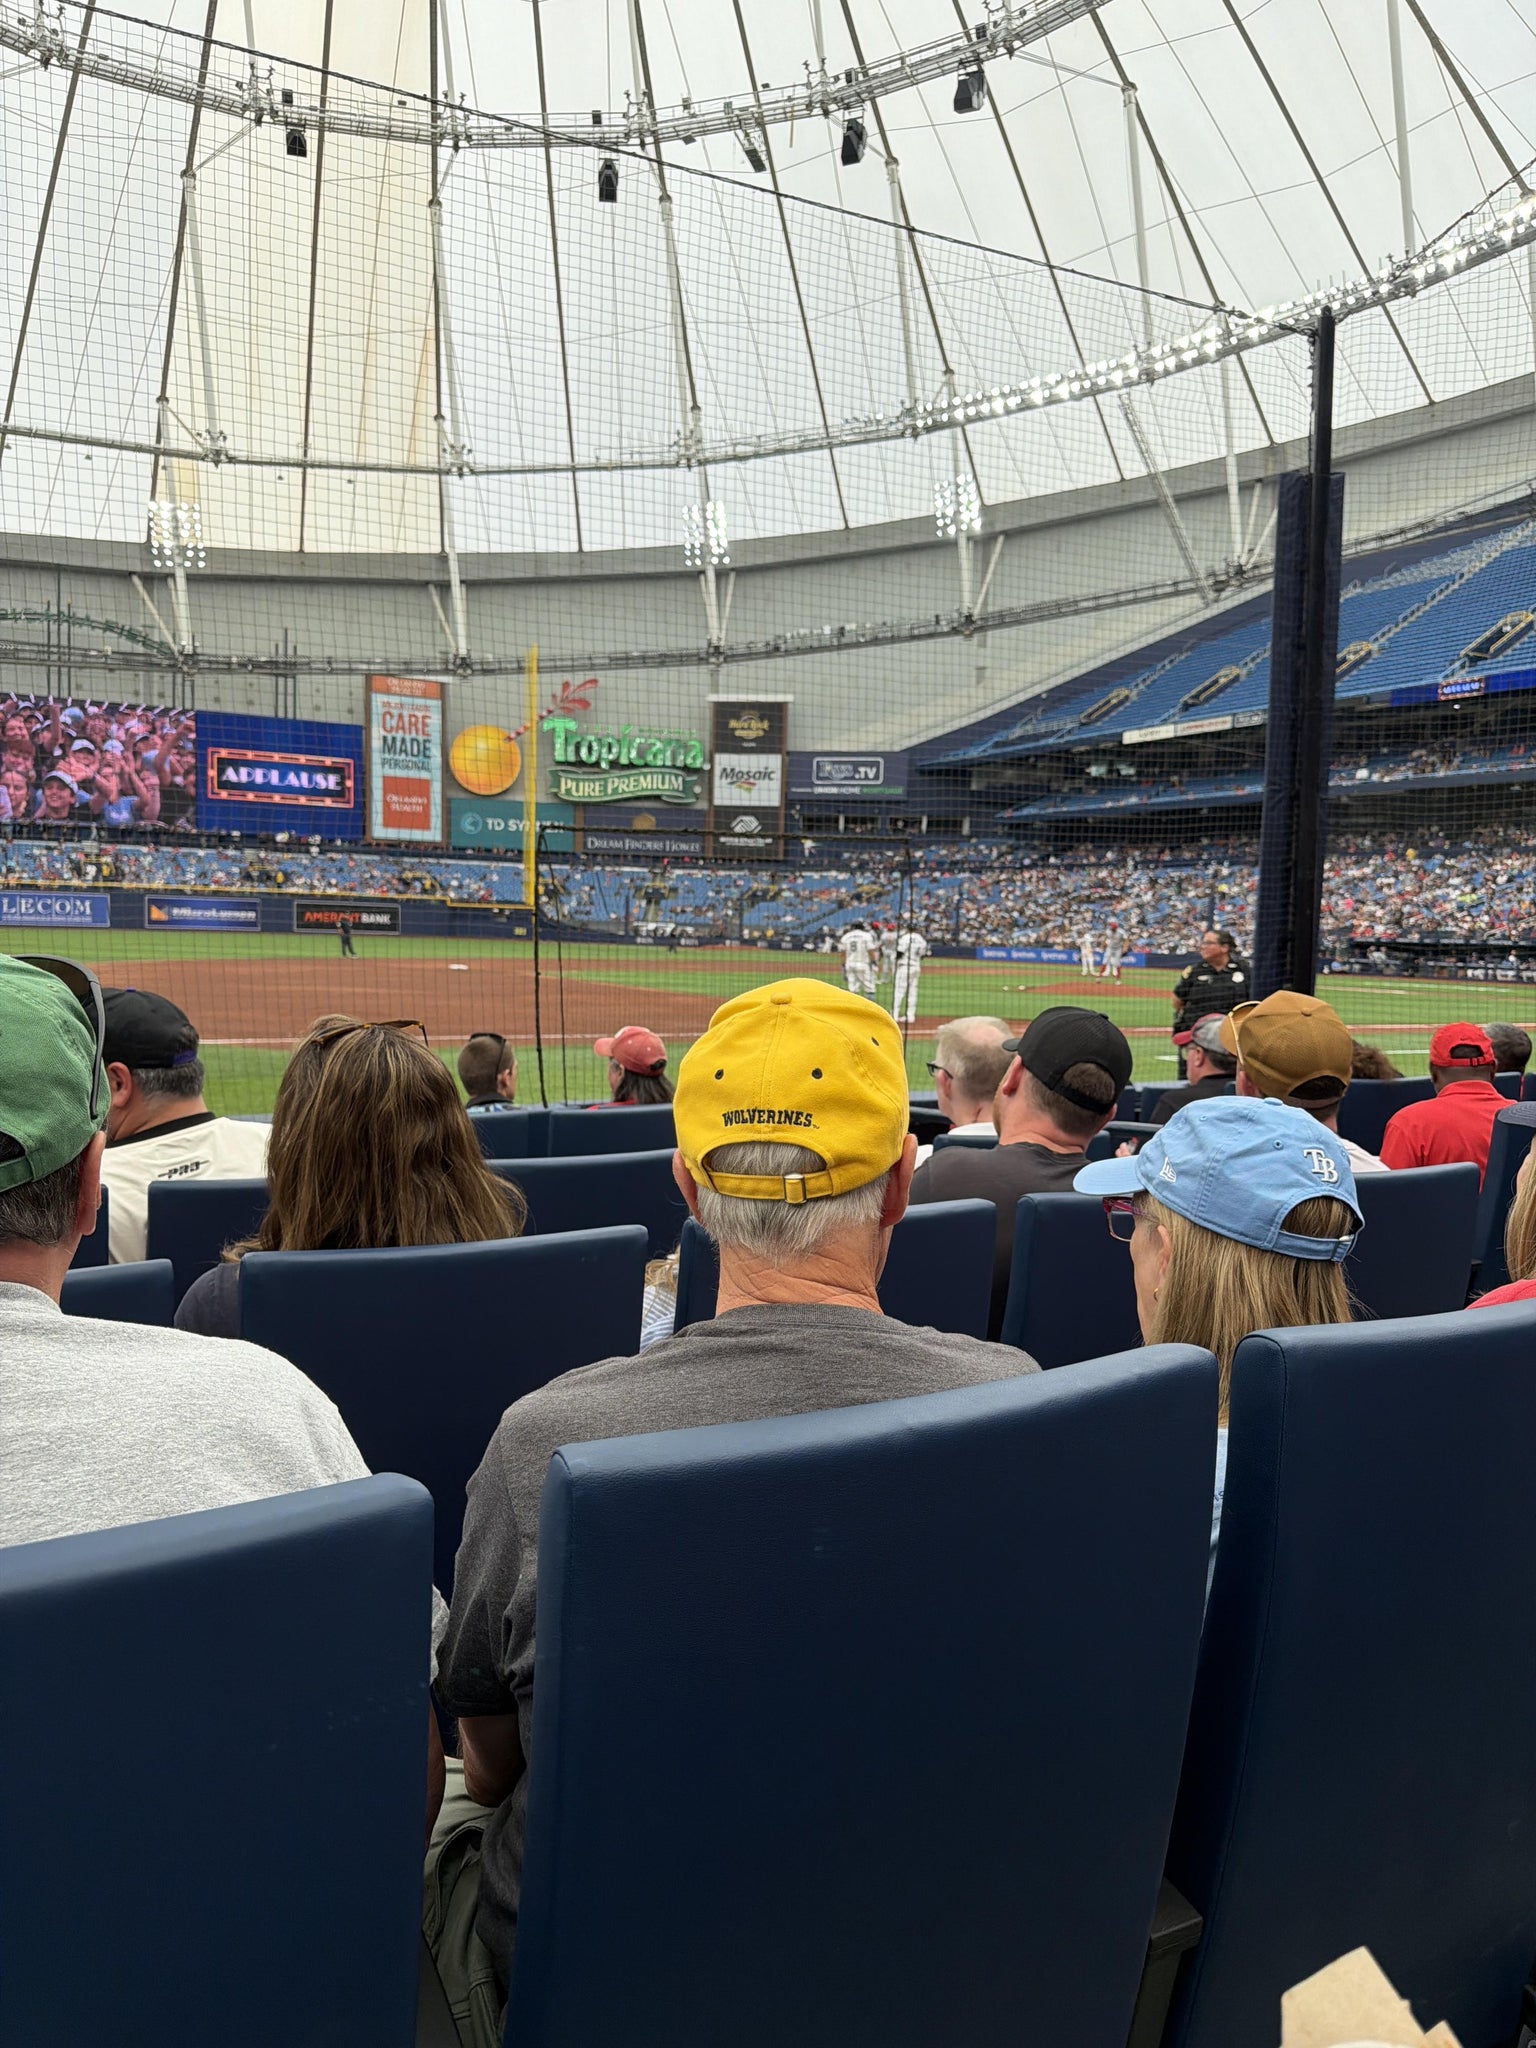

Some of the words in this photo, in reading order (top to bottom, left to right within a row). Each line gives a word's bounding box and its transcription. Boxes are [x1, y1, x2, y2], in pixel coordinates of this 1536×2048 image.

[382, 711, 432, 737] CARE
[382, 735, 432, 759] MADE
[542, 717, 704, 770] Tropicana
[381, 757, 432, 773] PERSONAL
[720, 766, 776, 781] Mosaic
[222, 766, 342, 790] APPLAUSE
[559, 776, 605, 797] PURE
[607, 773, 684, 795] PREMIUM
[485, 817, 505, 831] TD
[2, 896, 92, 916] LECOM
[360, 912, 392, 925] BANK
[722, 1107, 813, 1127] WOLVERINES
[1303, 1149, 1339, 1183] TB
